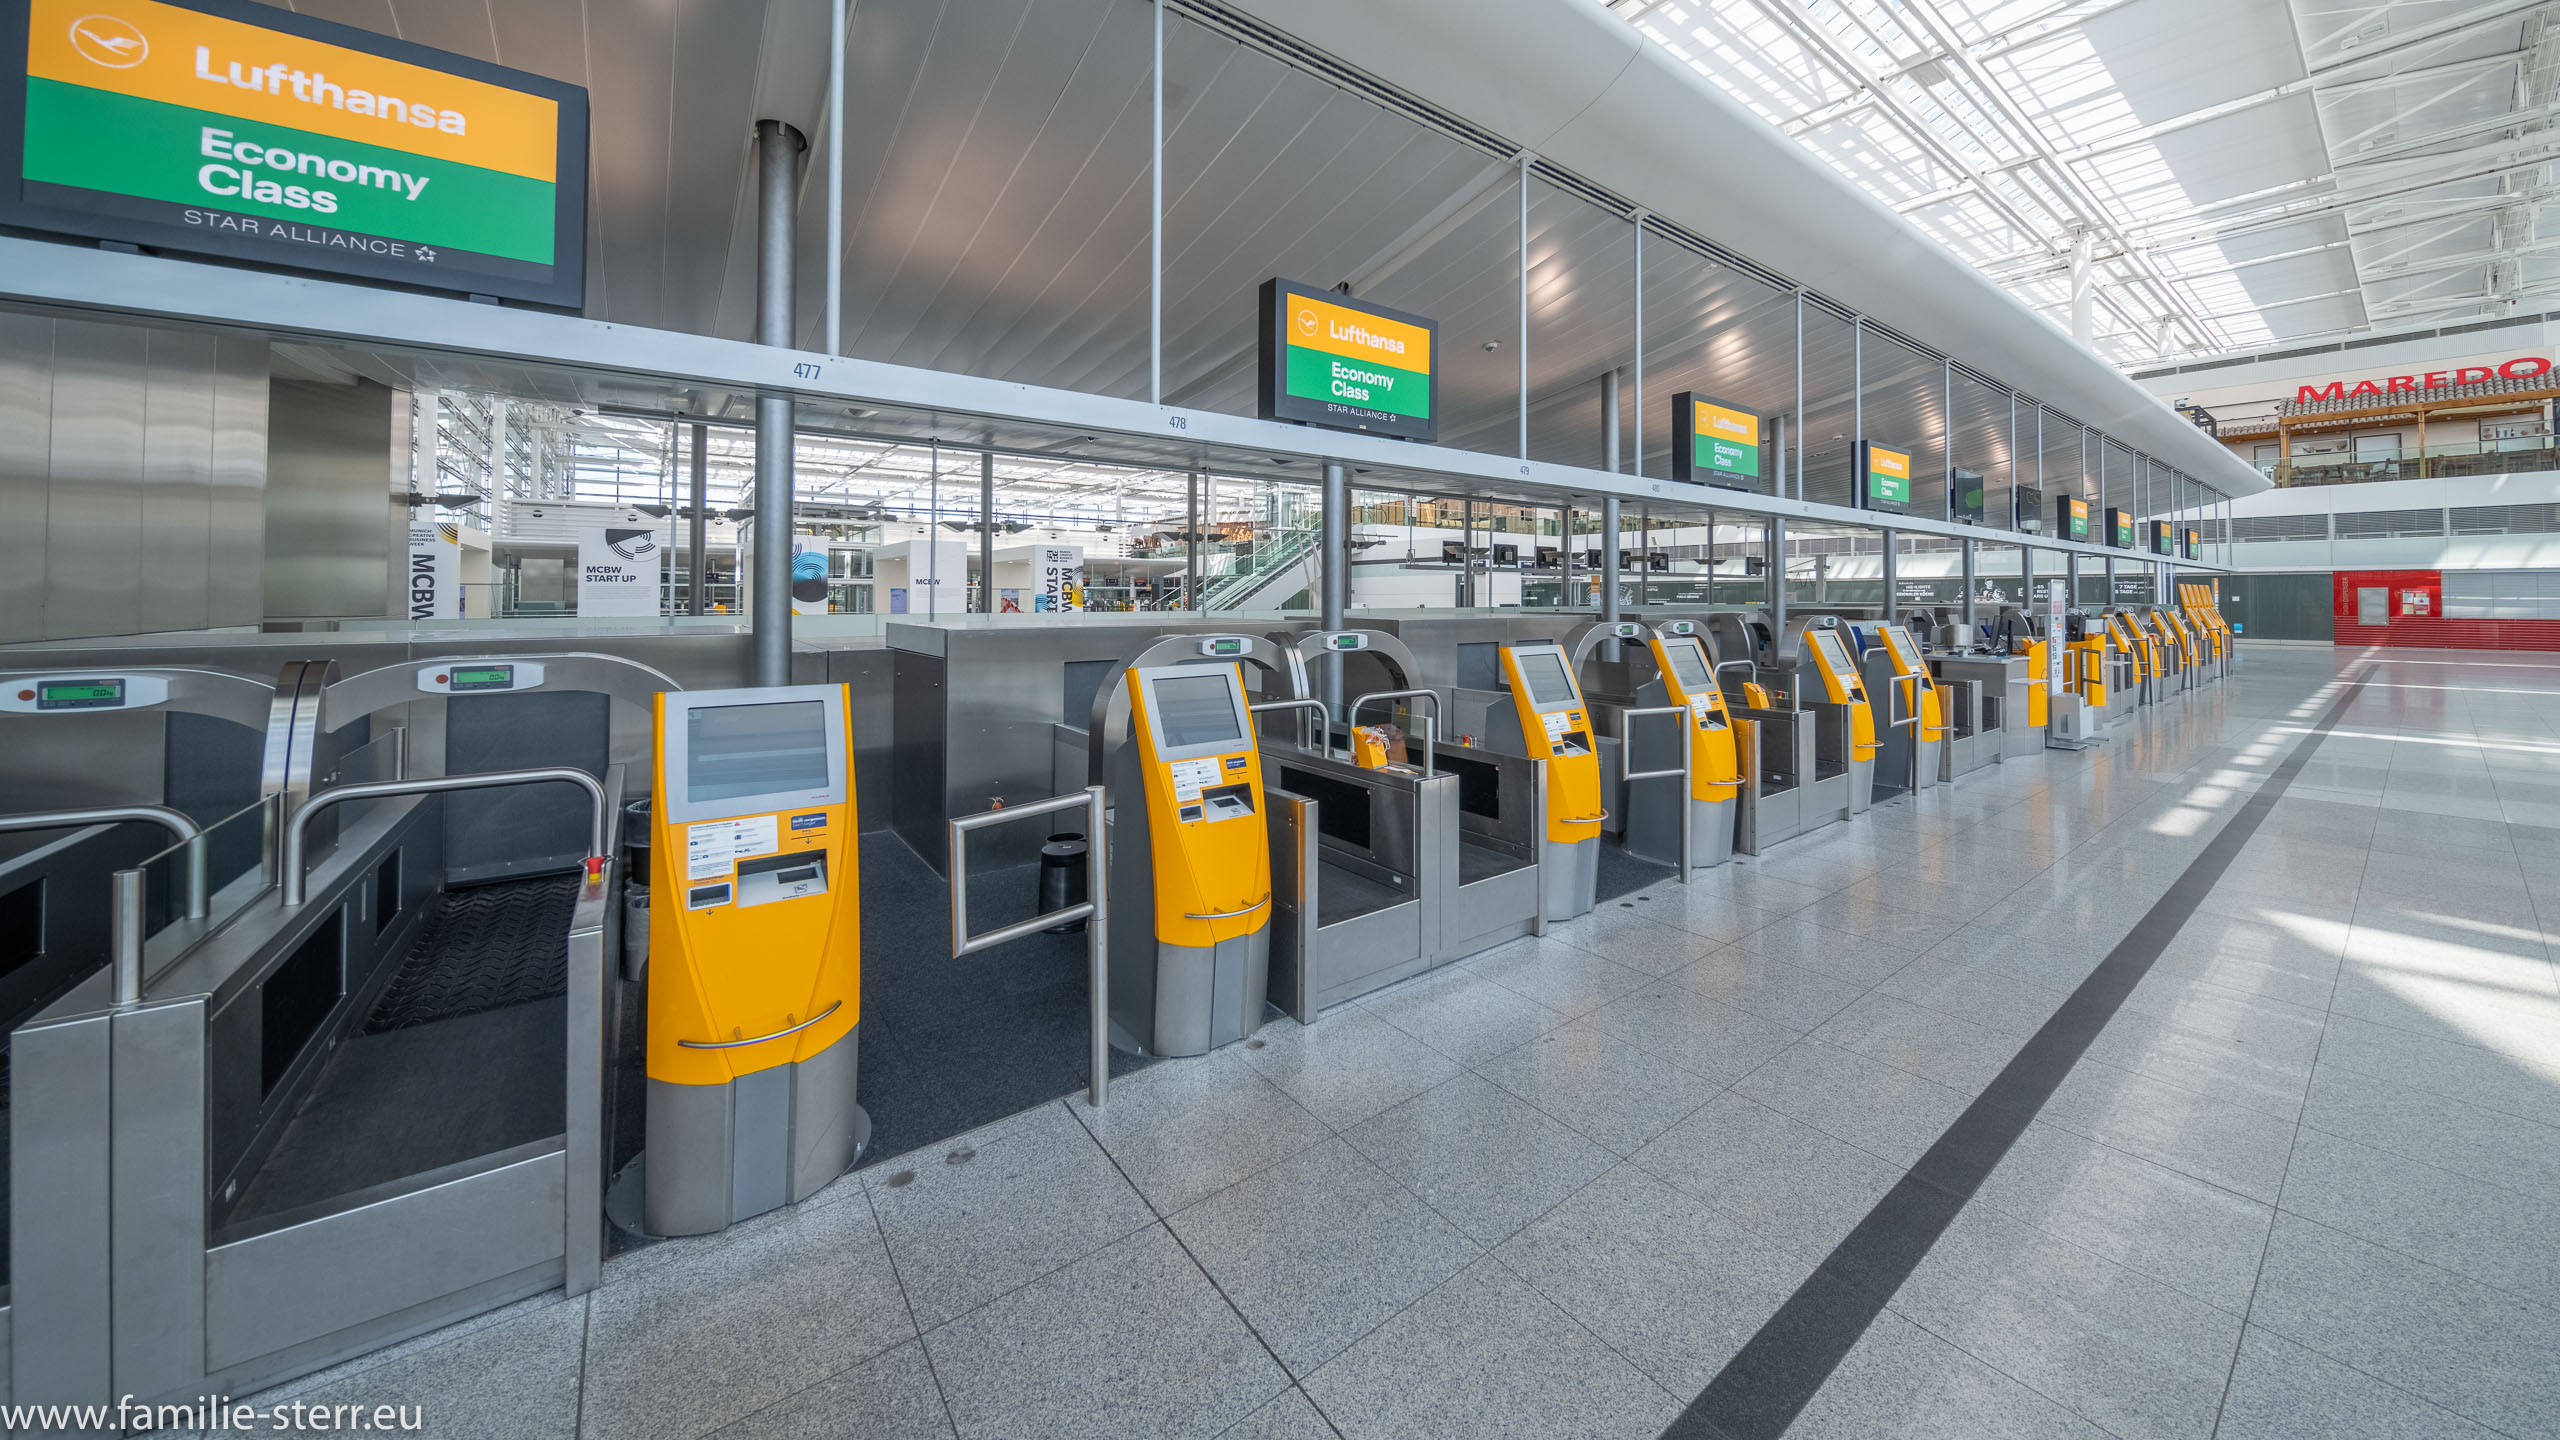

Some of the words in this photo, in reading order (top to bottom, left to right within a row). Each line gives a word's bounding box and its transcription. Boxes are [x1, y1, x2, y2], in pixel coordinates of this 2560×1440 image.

[195, 46, 466, 136] Lufthansa
[200, 126, 430, 201] Economy
[198, 163, 338, 214] Class
[184, 209, 259, 234] STAR
[270, 224, 405, 257] ALLIANCE
[1330, 319, 1405, 354] Lufthansa
[793, 362, 821, 380] 477
[1331, 361, 1395, 391] Economy
[2297, 357, 2551, 404] MAREDO
[1331, 380, 1370, 401] Class
[1169, 416, 1187, 430] 478
[1327, 403, 1349, 414] STAR
[1350, 407, 1388, 421] ALLIANCE
[1714, 442, 1743, 459] Economy
[1714, 454, 1732, 467] Class
[1519, 465, 1530, 475] 479
[411, 554, 435, 620] MCBW
[585, 574, 620, 583] START
